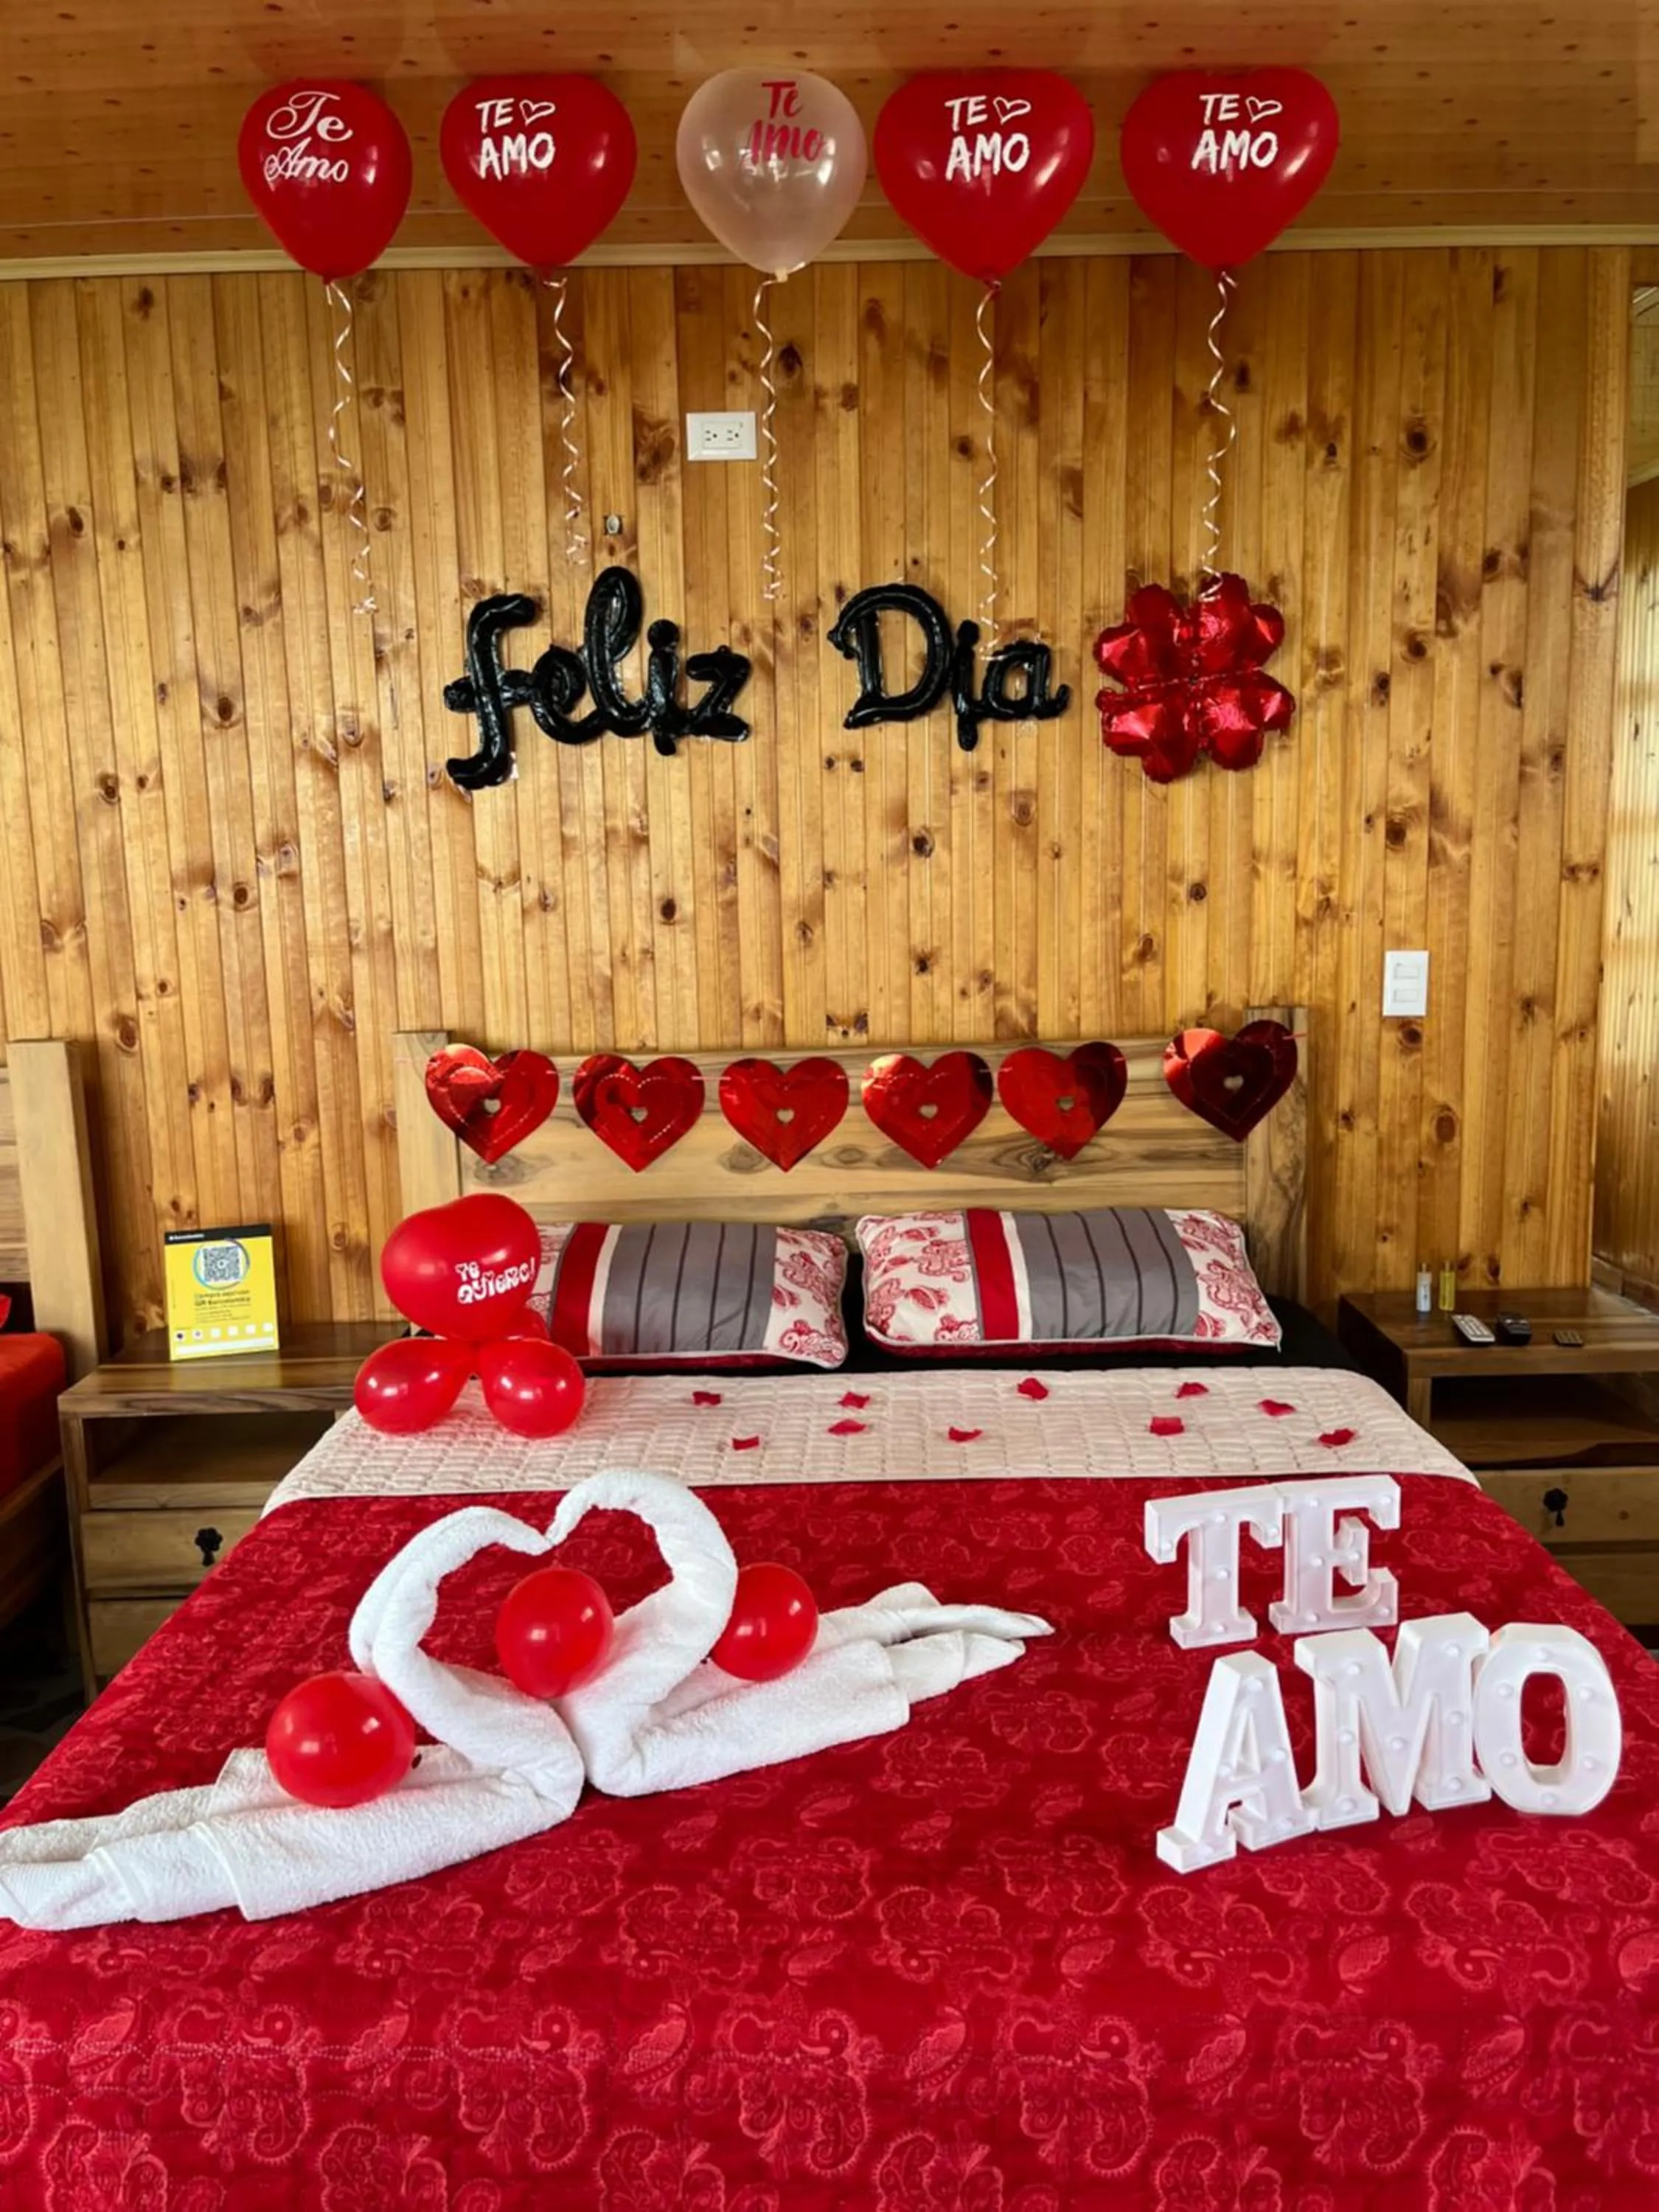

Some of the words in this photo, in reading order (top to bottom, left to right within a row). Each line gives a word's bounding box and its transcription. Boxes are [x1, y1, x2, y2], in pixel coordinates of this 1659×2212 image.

[266, 91, 353, 142] Te
[475, 97, 515, 133] TE
[762, 81, 804, 119] Te
[944, 94, 988, 132] TE
[1199, 93, 1240, 125] TE
[263, 136, 349, 192] Amo
[479, 131, 556, 181] AMO
[945, 131, 1030, 182] AMO
[1191, 128, 1278, 174] AMO
[1144, 1474, 1401, 1649] TE
[1156, 1611, 1622, 1874] AMO
